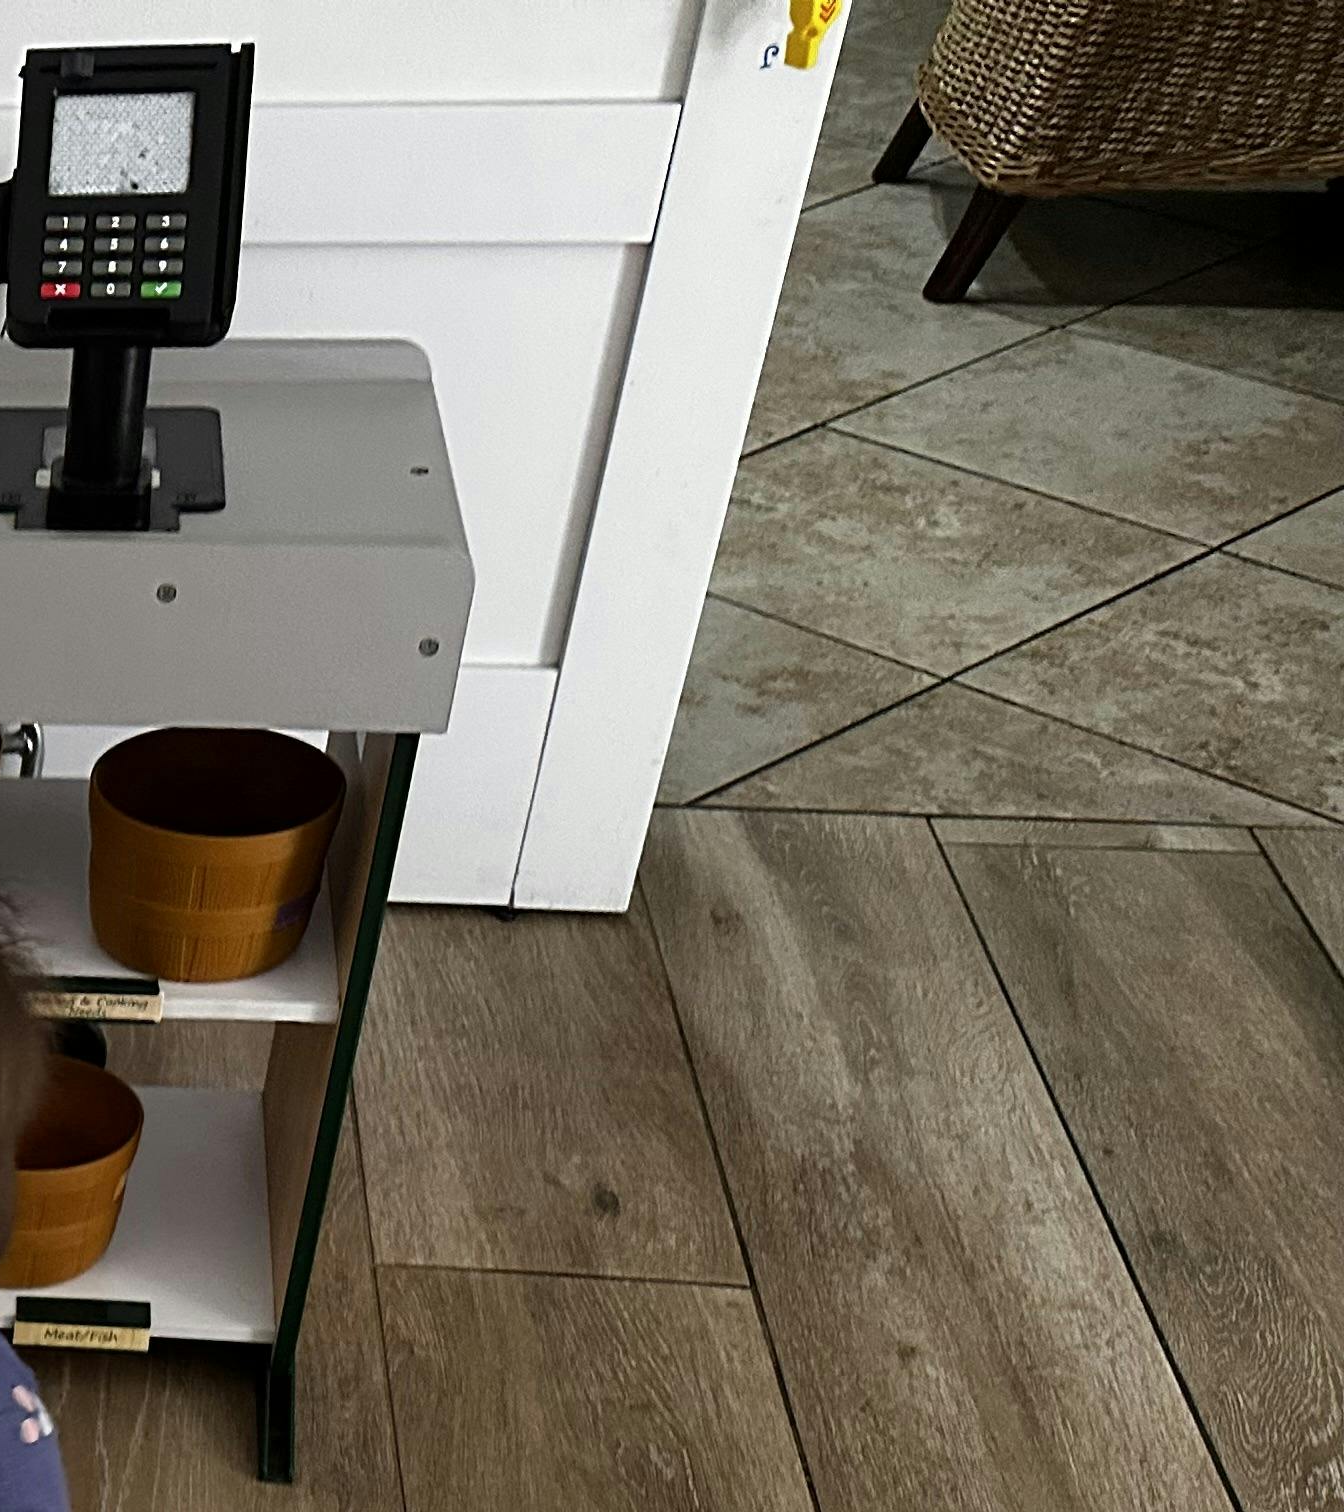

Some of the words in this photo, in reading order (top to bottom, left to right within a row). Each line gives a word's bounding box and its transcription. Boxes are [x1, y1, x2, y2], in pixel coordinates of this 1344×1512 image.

[62, 216, 69, 229] 1
[111, 216, 120, 229] 2
[59, 238, 68, 251] 4
[58, 261, 67, 273] 7
[43, 1327, 118, 1343] Meat/Fish
